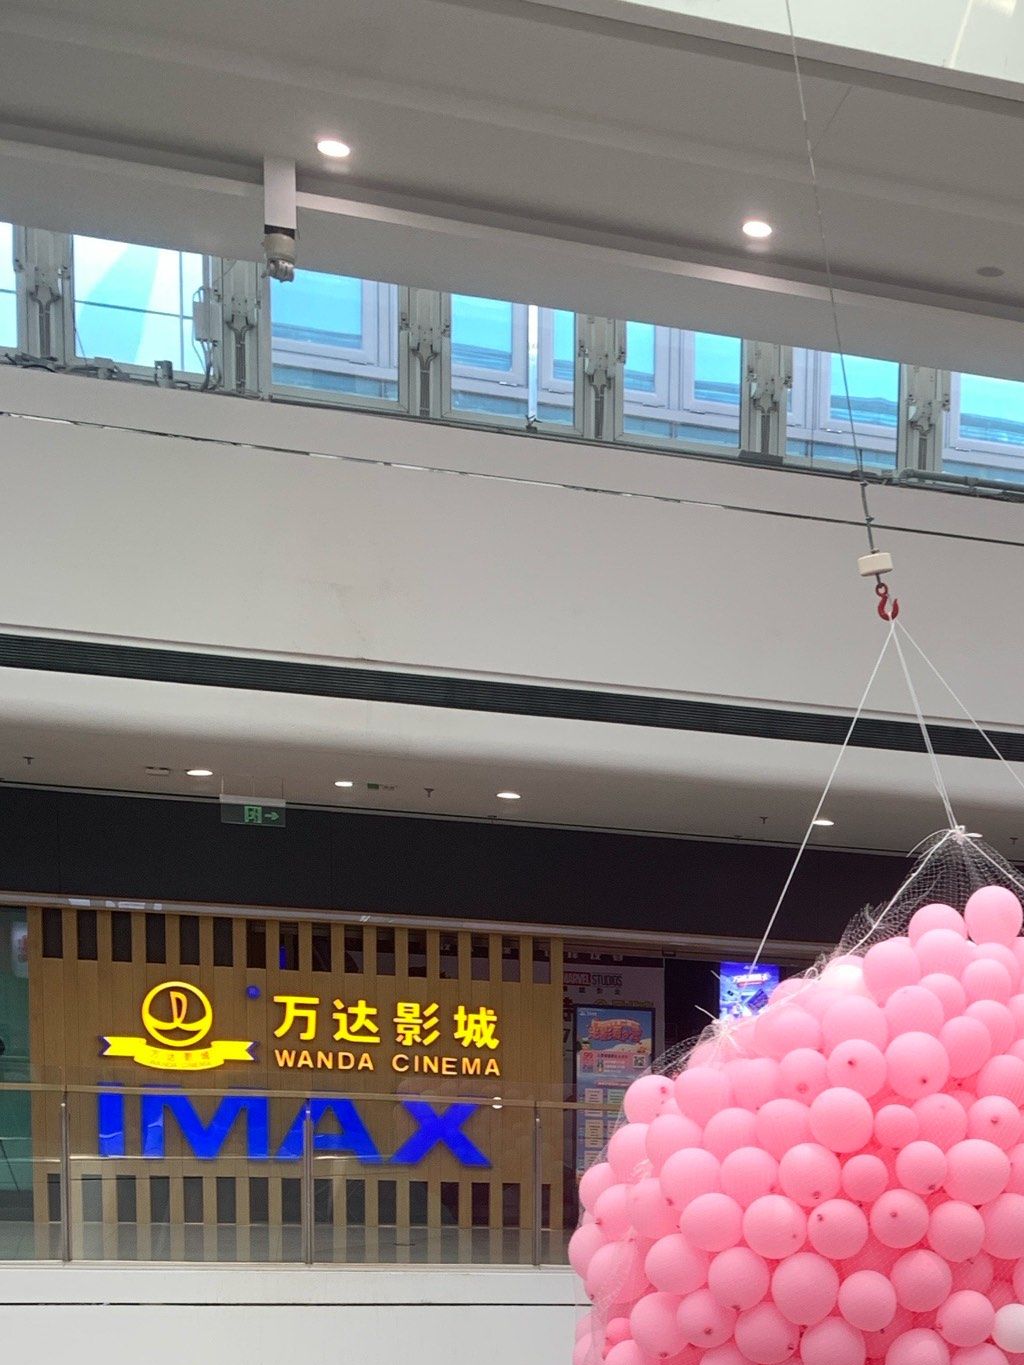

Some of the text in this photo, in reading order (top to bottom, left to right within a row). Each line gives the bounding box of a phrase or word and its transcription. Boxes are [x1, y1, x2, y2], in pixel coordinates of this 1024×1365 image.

[563, 972, 592, 986] ARVEL
[273, 995, 500, 1049] 万达影城
[273, 1048, 501, 1077] WANDA CINEMA
[97, 1081, 492, 1169] IMAX
